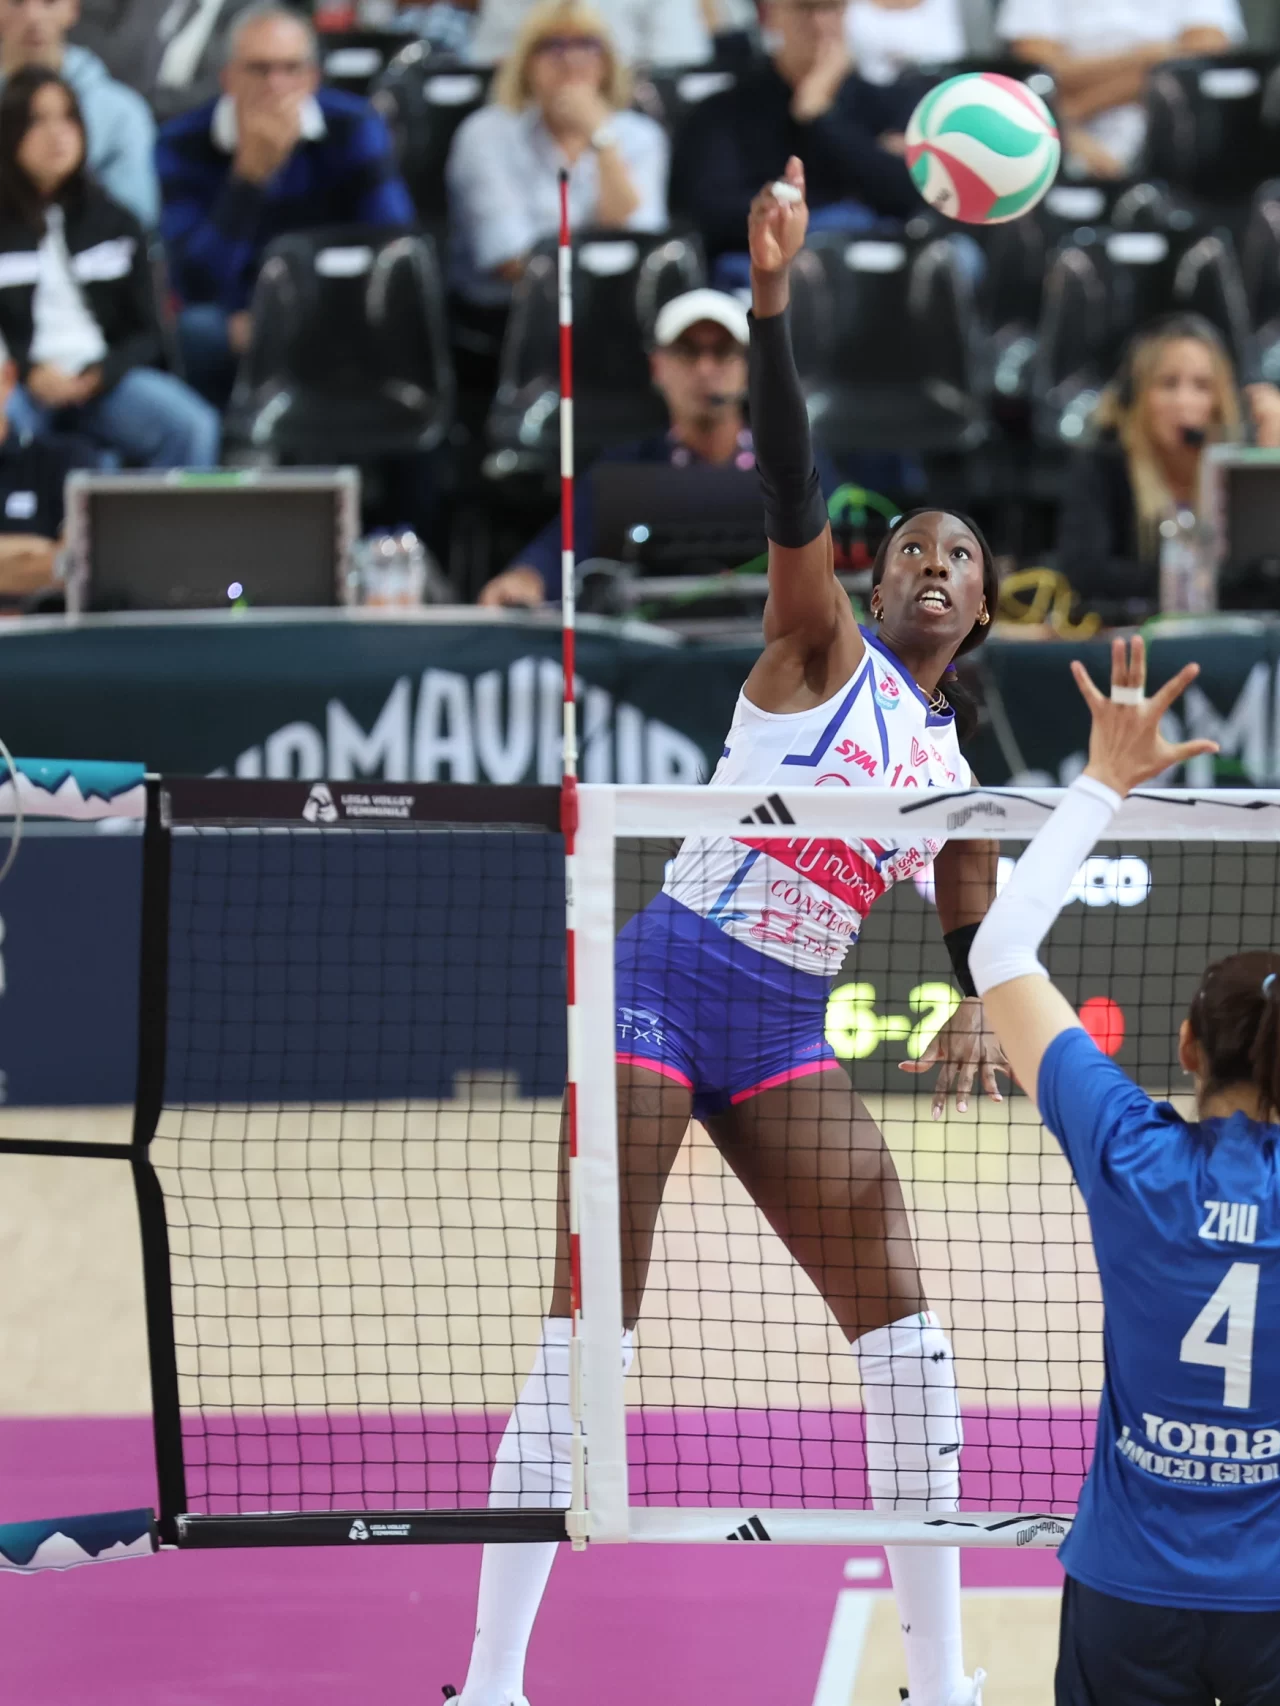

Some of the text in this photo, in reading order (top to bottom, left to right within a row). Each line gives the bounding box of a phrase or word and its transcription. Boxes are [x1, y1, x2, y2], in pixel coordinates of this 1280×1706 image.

[834, 739, 878, 778] SYM
[616, 1023, 667, 1046] TXT
[1198, 1200, 1258, 1244] ZHU
[1179, 1262, 1260, 1409] 4
[1016, 1521, 1066, 1546] COURMAYEUR
